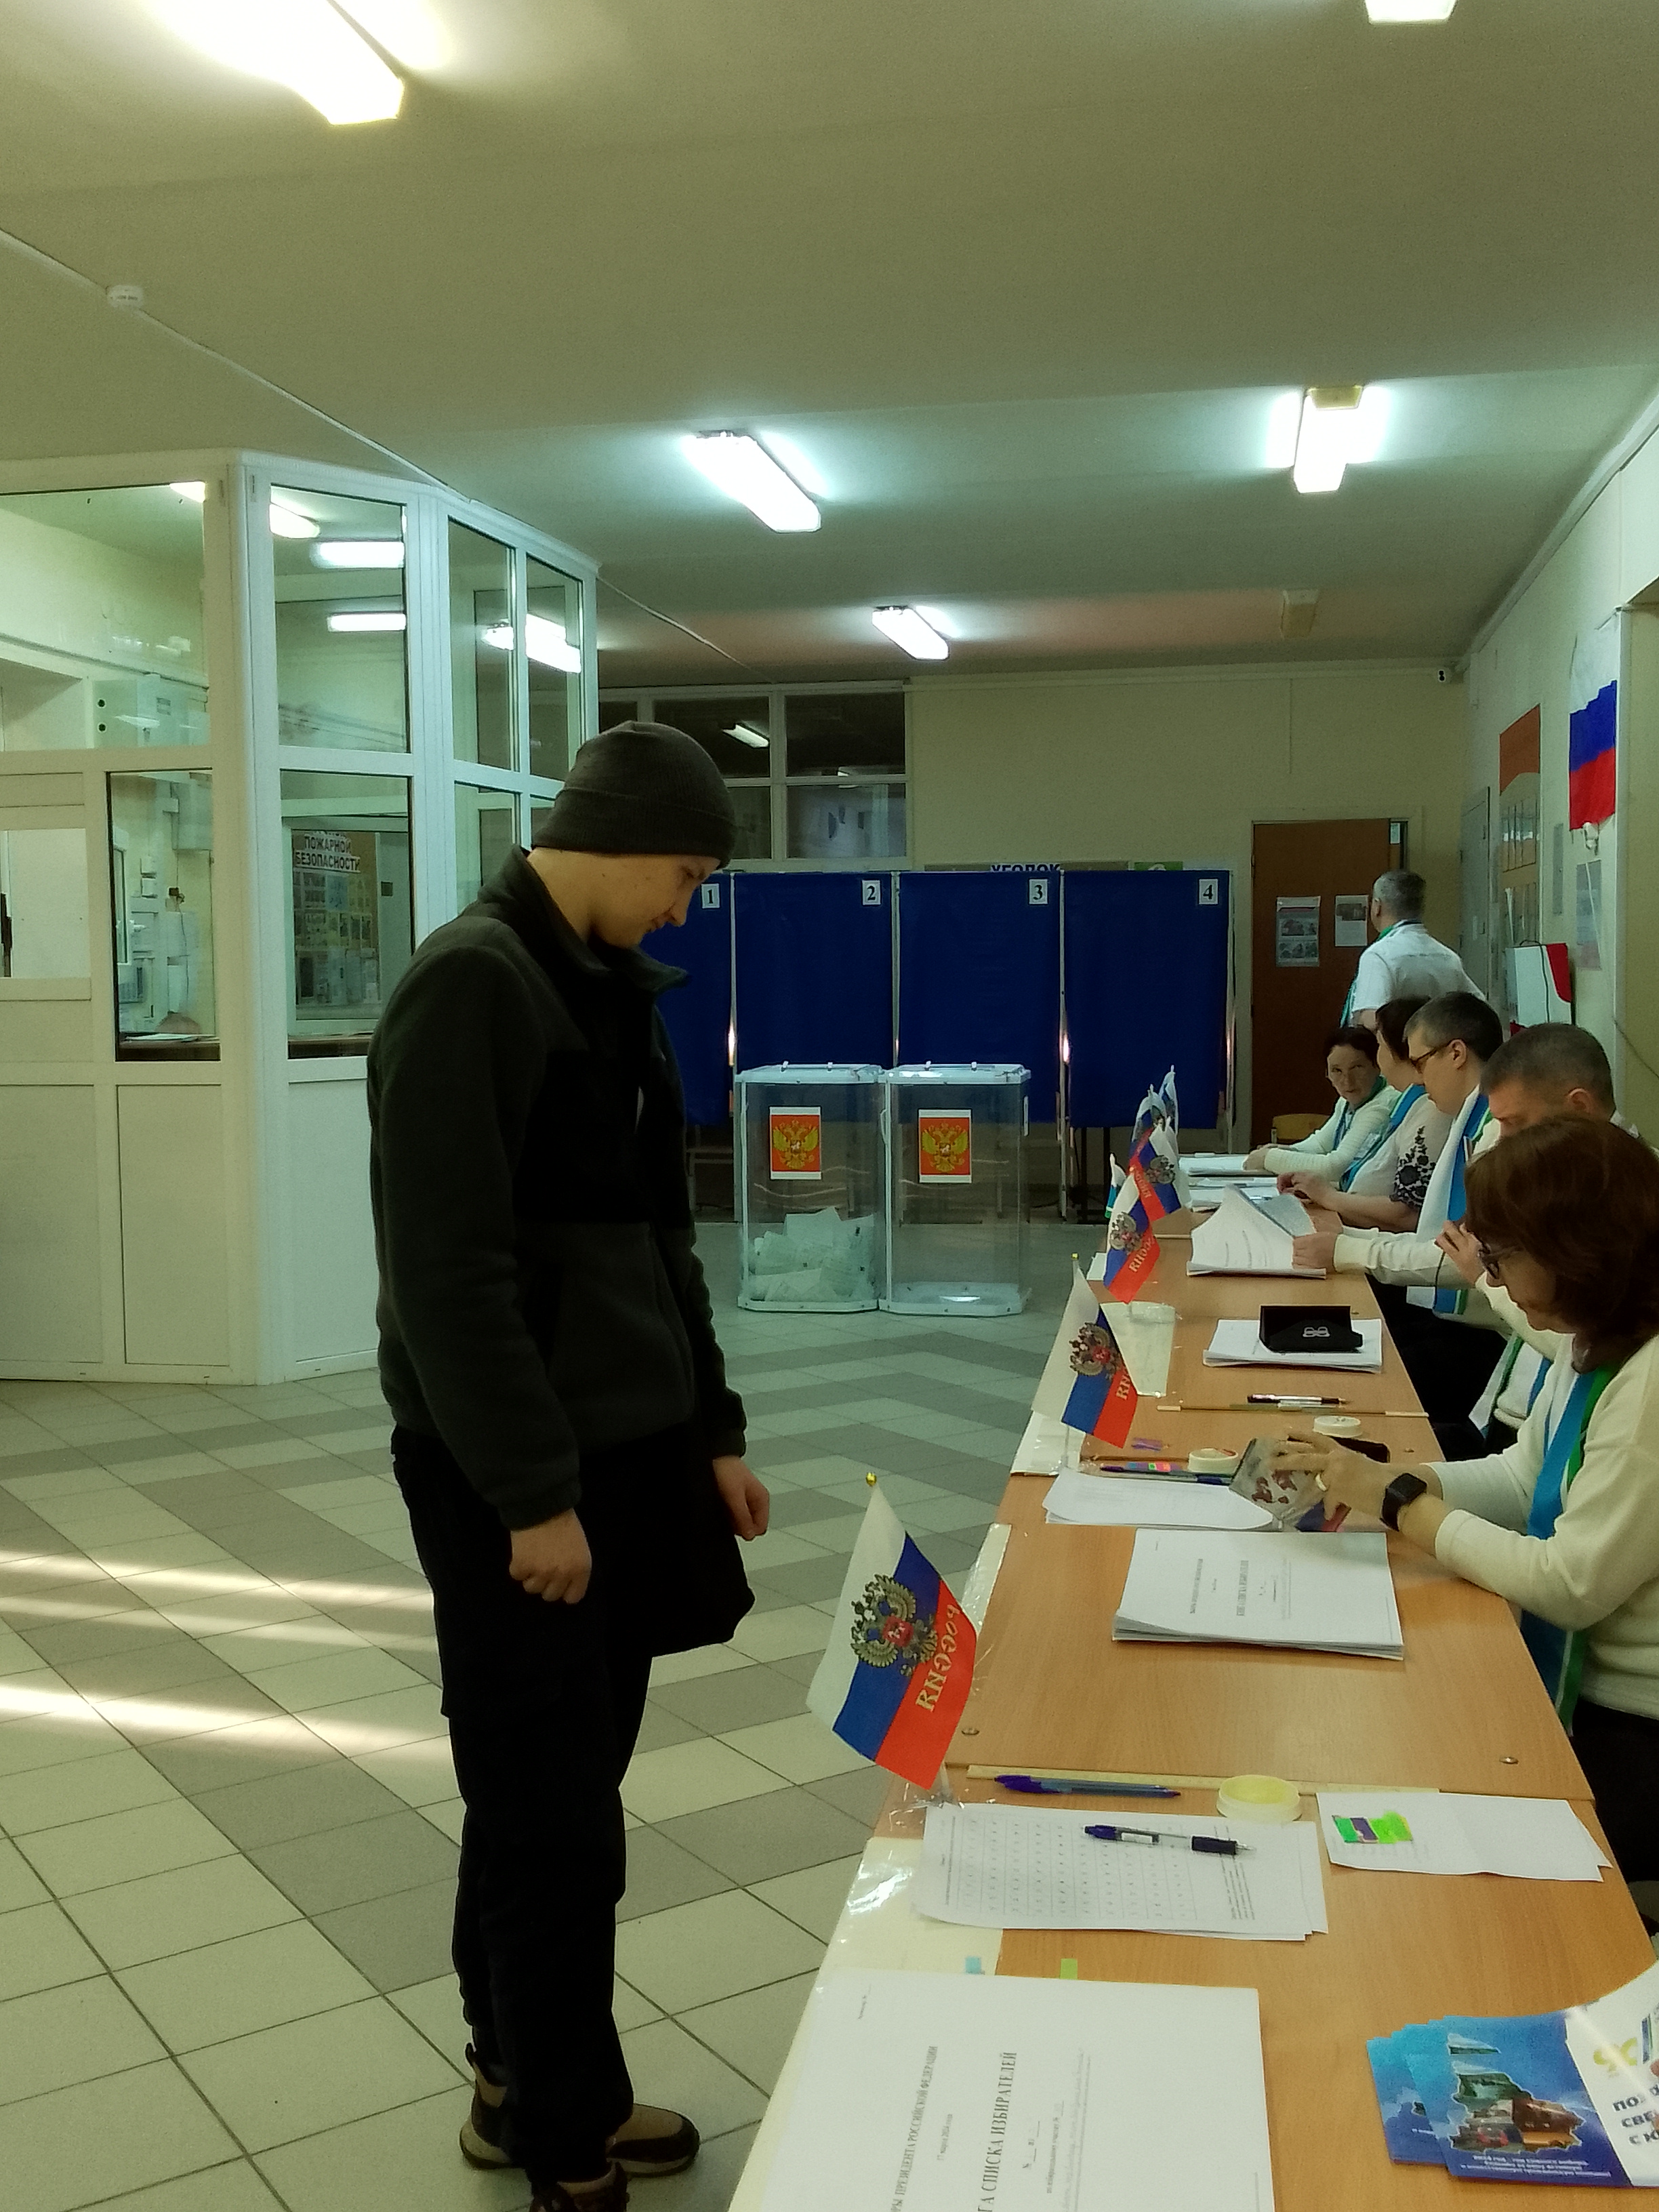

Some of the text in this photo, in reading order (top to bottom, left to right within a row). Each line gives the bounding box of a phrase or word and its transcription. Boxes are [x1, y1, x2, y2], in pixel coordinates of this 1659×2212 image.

[295, 852, 361, 872] БЕЗОПАСНОСТИ
[707, 889, 714, 904] 1
[867, 885, 876, 901] 2
[1033, 884, 1043, 901] 3
[1203, 884, 1213, 900] 4
[990, 2052, 1017, 2135] ИЗБИРАТЕЛЕЙ
[907, 2089, 928, 2142] РОССИЙСКОЙ
[981, 2139, 1004, 2192] СПИСКА
